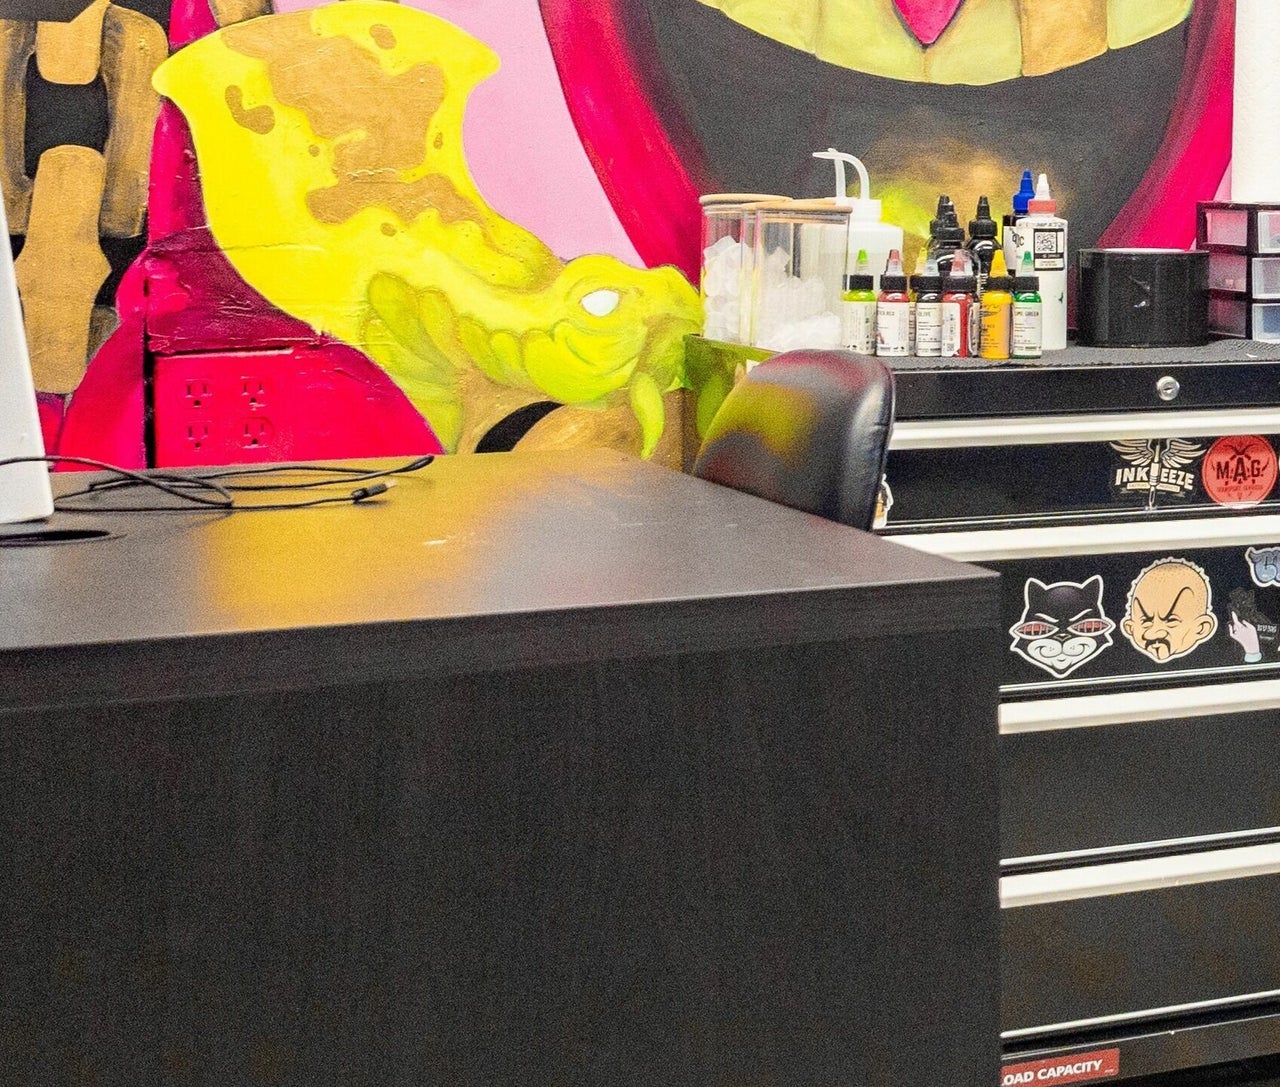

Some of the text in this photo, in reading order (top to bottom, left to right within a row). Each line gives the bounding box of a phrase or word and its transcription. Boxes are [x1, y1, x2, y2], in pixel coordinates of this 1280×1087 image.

[1115, 466, 1150, 486] INK
[1160, 467, 1195, 491] EEZE
[1001, 1059, 1103, 1087] OAD CAPACITY
